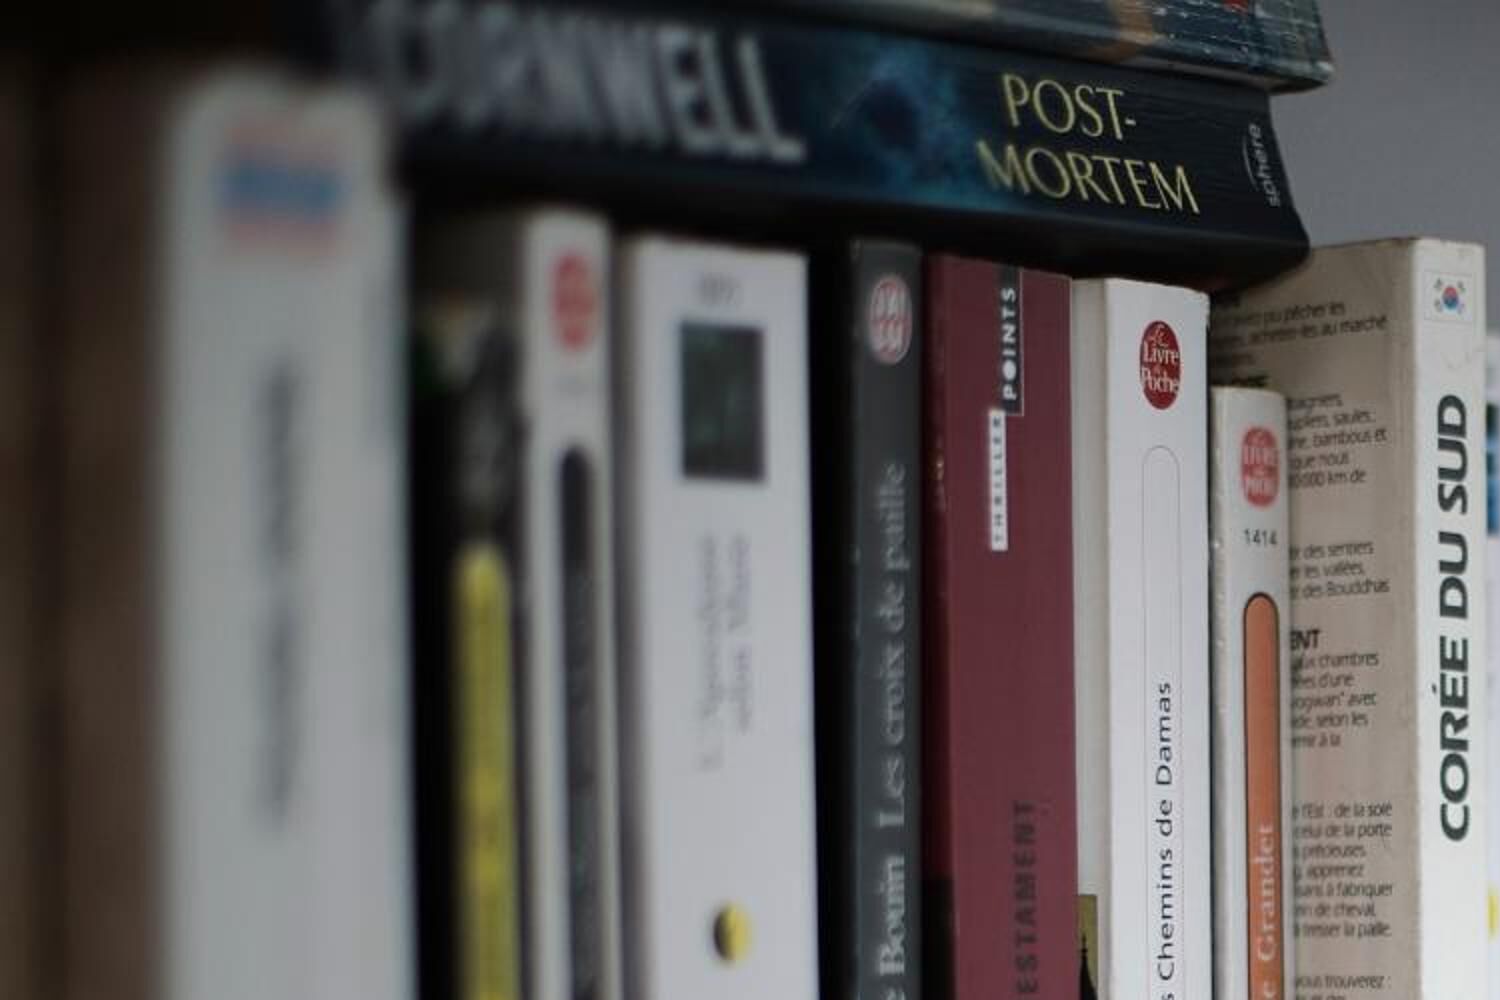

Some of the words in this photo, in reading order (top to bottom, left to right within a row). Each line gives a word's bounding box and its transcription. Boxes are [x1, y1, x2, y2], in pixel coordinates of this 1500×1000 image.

[345, 0, 808, 165] ORNWELL
[1002, 73, 1137, 141] POST-
[975, 138, 1201, 216] MORTEM
[1248, 122, 1282, 208] sphere
[1001, 286, 1018, 401] POINTS
[1141, 367, 1181, 393] Poche
[1142, 342, 1181, 367] Livre
[991, 414, 1005, 544] THRILLER
[1436, 394, 1469, 514] SUD
[874, 463, 908, 574] paille
[1244, 528, 1279, 546] 1414
[875, 581, 904, 633] de
[1437, 531, 1470, 619] DU
[876, 642, 904, 746] croix
[1154, 683, 1173, 789] Damas
[1432, 635, 1470, 842] CORÉE
[876, 756, 904, 830] Les
[1154, 800, 1174, 839] de
[876, 855, 906, 976] Bouin
[1155, 848, 1176, 985] Chemins
[1250, 824, 1276, 963] Grandet
